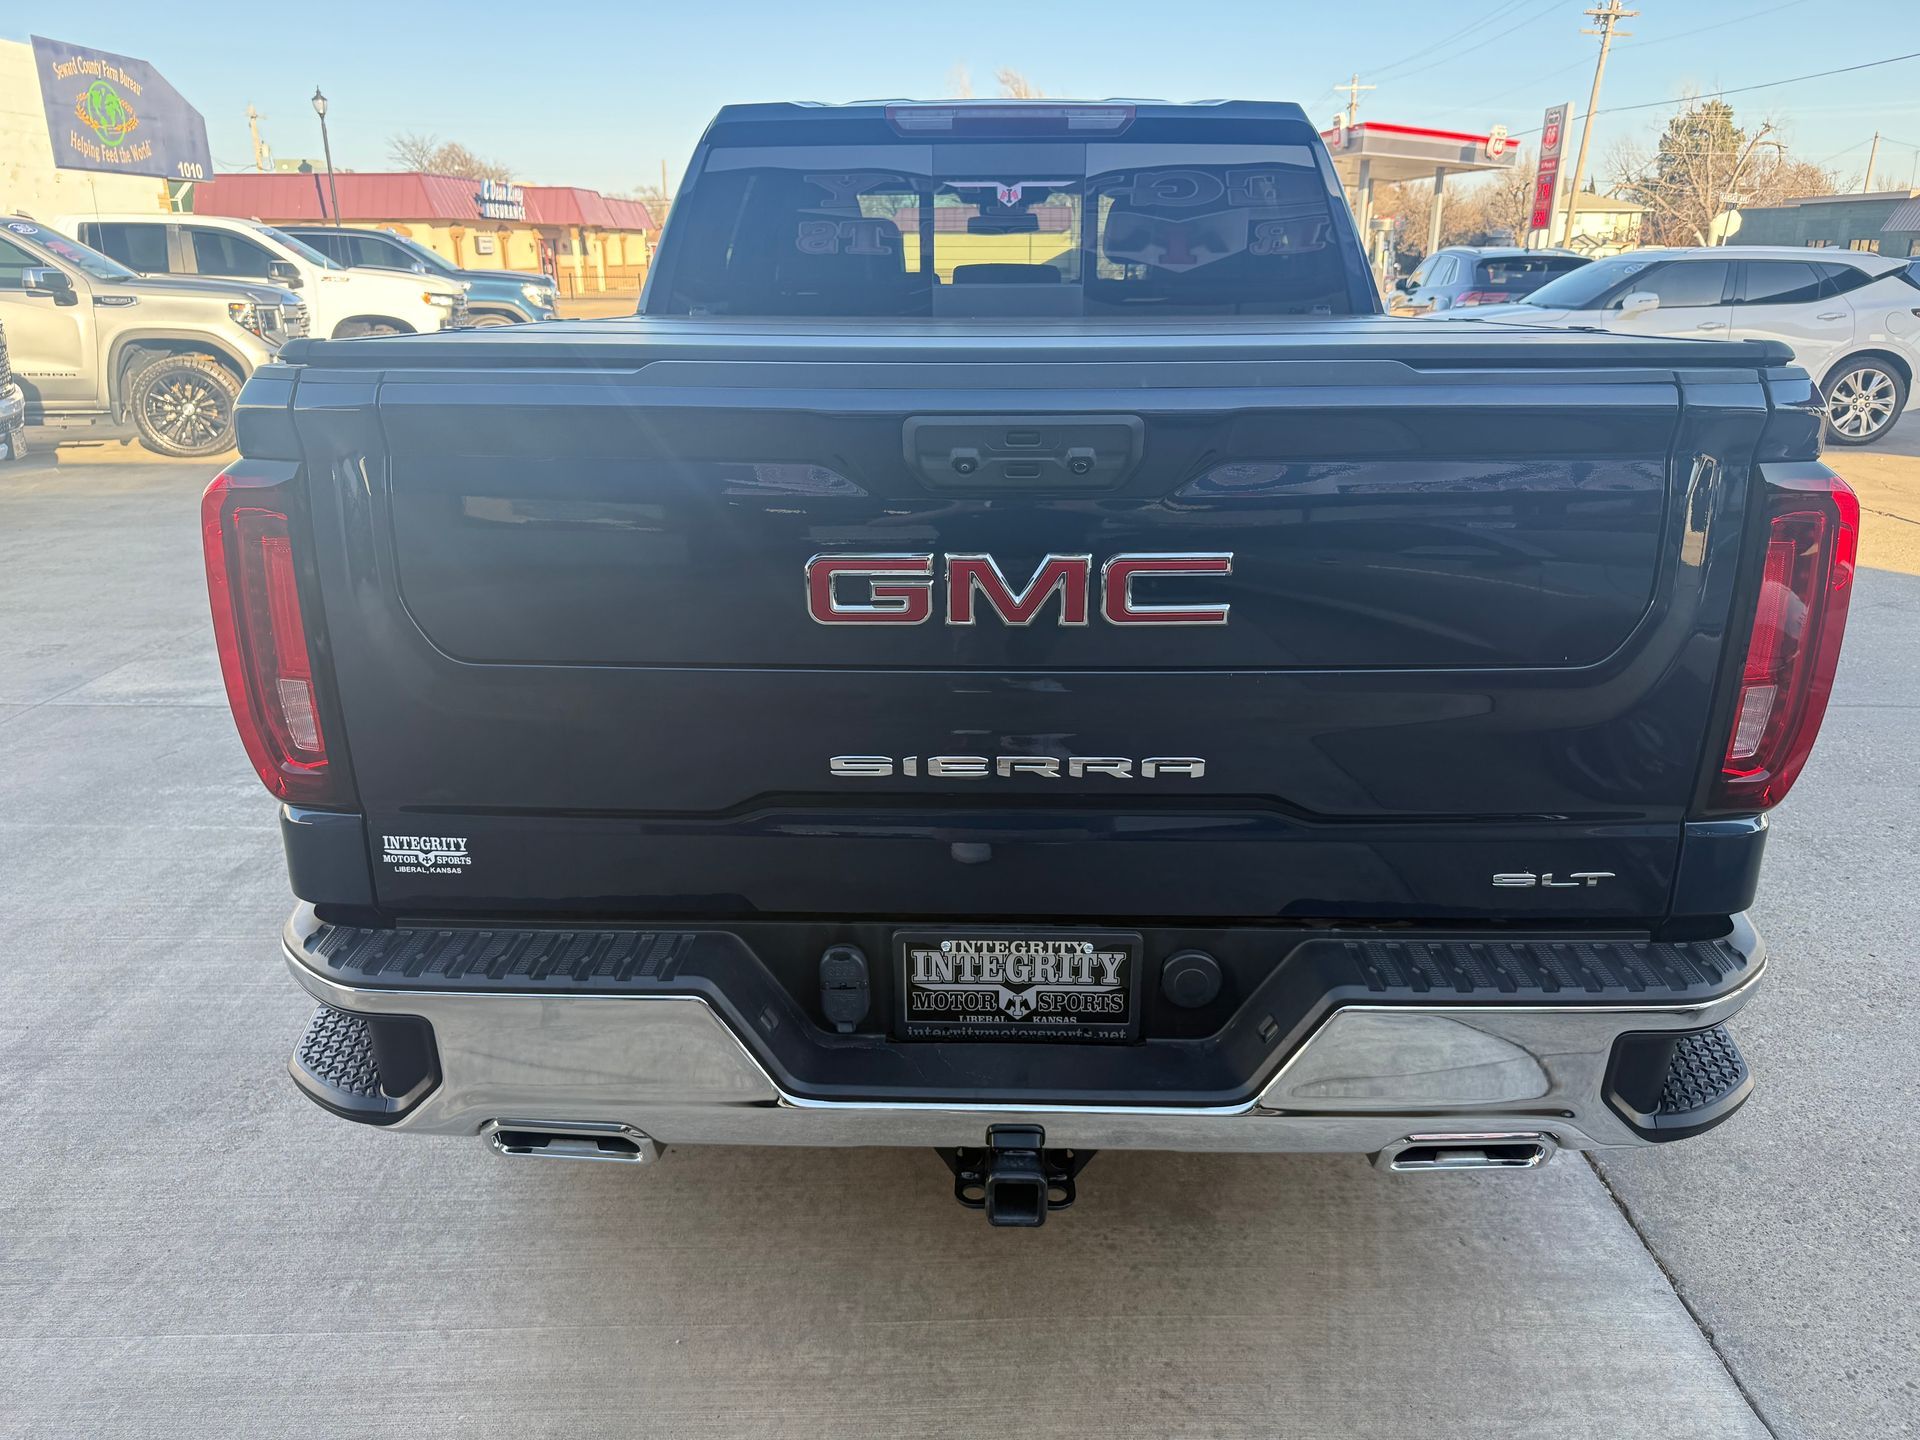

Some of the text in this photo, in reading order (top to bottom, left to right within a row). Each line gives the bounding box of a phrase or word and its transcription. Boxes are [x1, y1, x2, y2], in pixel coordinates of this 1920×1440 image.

[77, 56, 101, 79] County
[102, 60, 119, 82] Farm
[119, 67, 142, 97] Bureau
[70, 129, 101, 163] Helping
[101, 143, 119, 164] Feed
[119, 146, 132, 164] the
[177, 161, 203, 179] 1010
[485, 203, 527, 221] INSURANCE
[804, 552, 1234, 627] GMC
[829, 755, 1206, 779] SIERRA
[382, 835, 467, 851] INTEGRITY
[382, 854, 472, 865] MOTOR SPORTS
[394, 866, 462, 874] LIBERAL, KANSAS
[1492, 872, 1616, 887] SLT
[949, 940, 1086, 955] INTEGRITY
[912, 950, 1127, 985] INTEGRITY
[912, 991, 998, 1011] MOTOR
[1037, 993, 1124, 1013] SPORTS
[959, 1014, 1077, 1024] LIBERAL KANSAS
